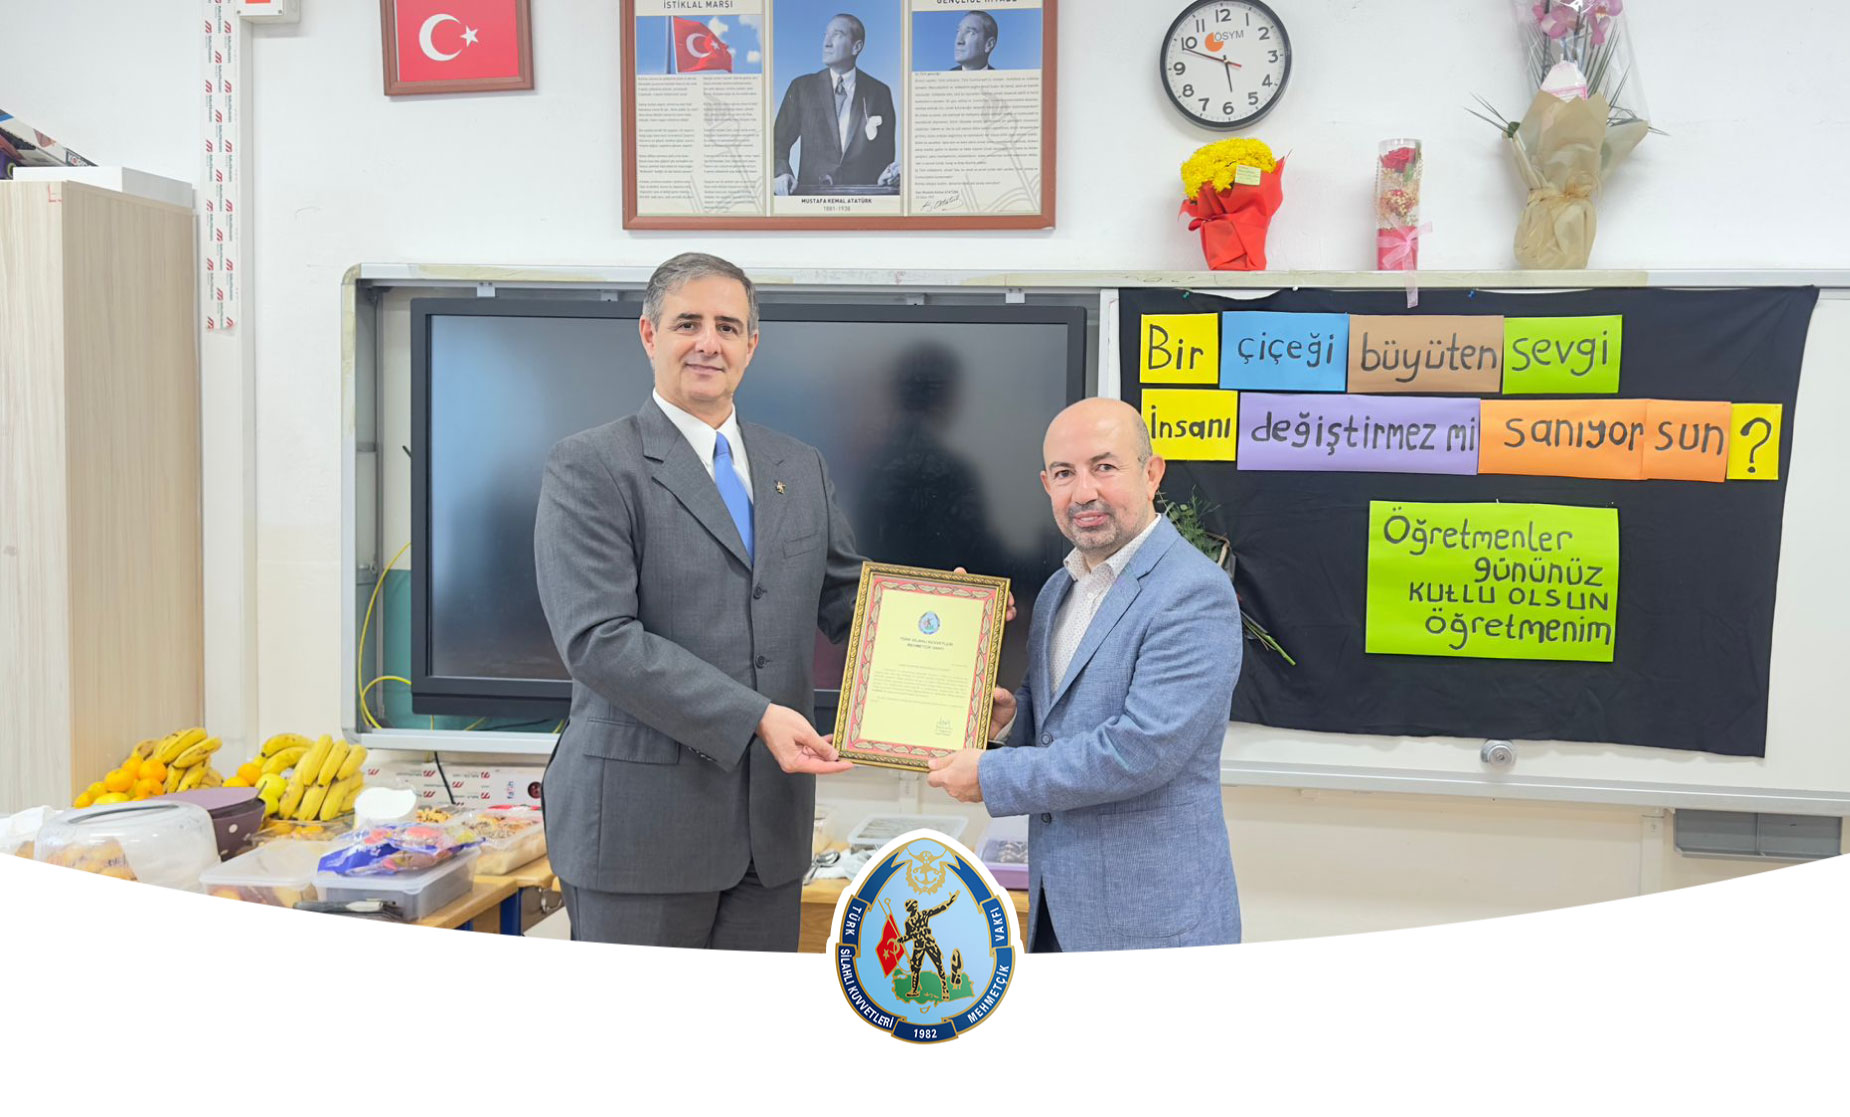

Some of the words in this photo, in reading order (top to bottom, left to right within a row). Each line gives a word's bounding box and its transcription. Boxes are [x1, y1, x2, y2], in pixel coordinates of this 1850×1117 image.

[1215, 8, 1232, 23] 12
[1246, 12, 1250, 27] 1
[1195, 18, 1206, 33] 11
[1257, 26, 1270, 41] 2
[1181, 36, 1198, 51] 10
[1267, 50, 1279, 63] 3
[1173, 61, 1186, 76] 9
[1261, 73, 1273, 88] 4
[1182, 83, 1195, 98] 8
[1197, 97, 1210, 112] 7
[1247, 91, 1259, 106] 5
[1222, 101, 1235, 116] 6
[1148, 324, 1204, 370] Bir
[1237, 334, 1335, 367] çiçeği
[1361, 338, 1498, 383] büyüten
[1251, 411, 1437, 456] değiştirmez
[1446, 416, 1476, 452] mi
[1504, 418, 1644, 452] sanıyor
[1656, 421, 1724, 455] sun
[1739, 417, 1773, 474] ?
[1384, 507, 1573, 556] Öğretmenler
[1508, 587, 1609, 611] OLSUN
